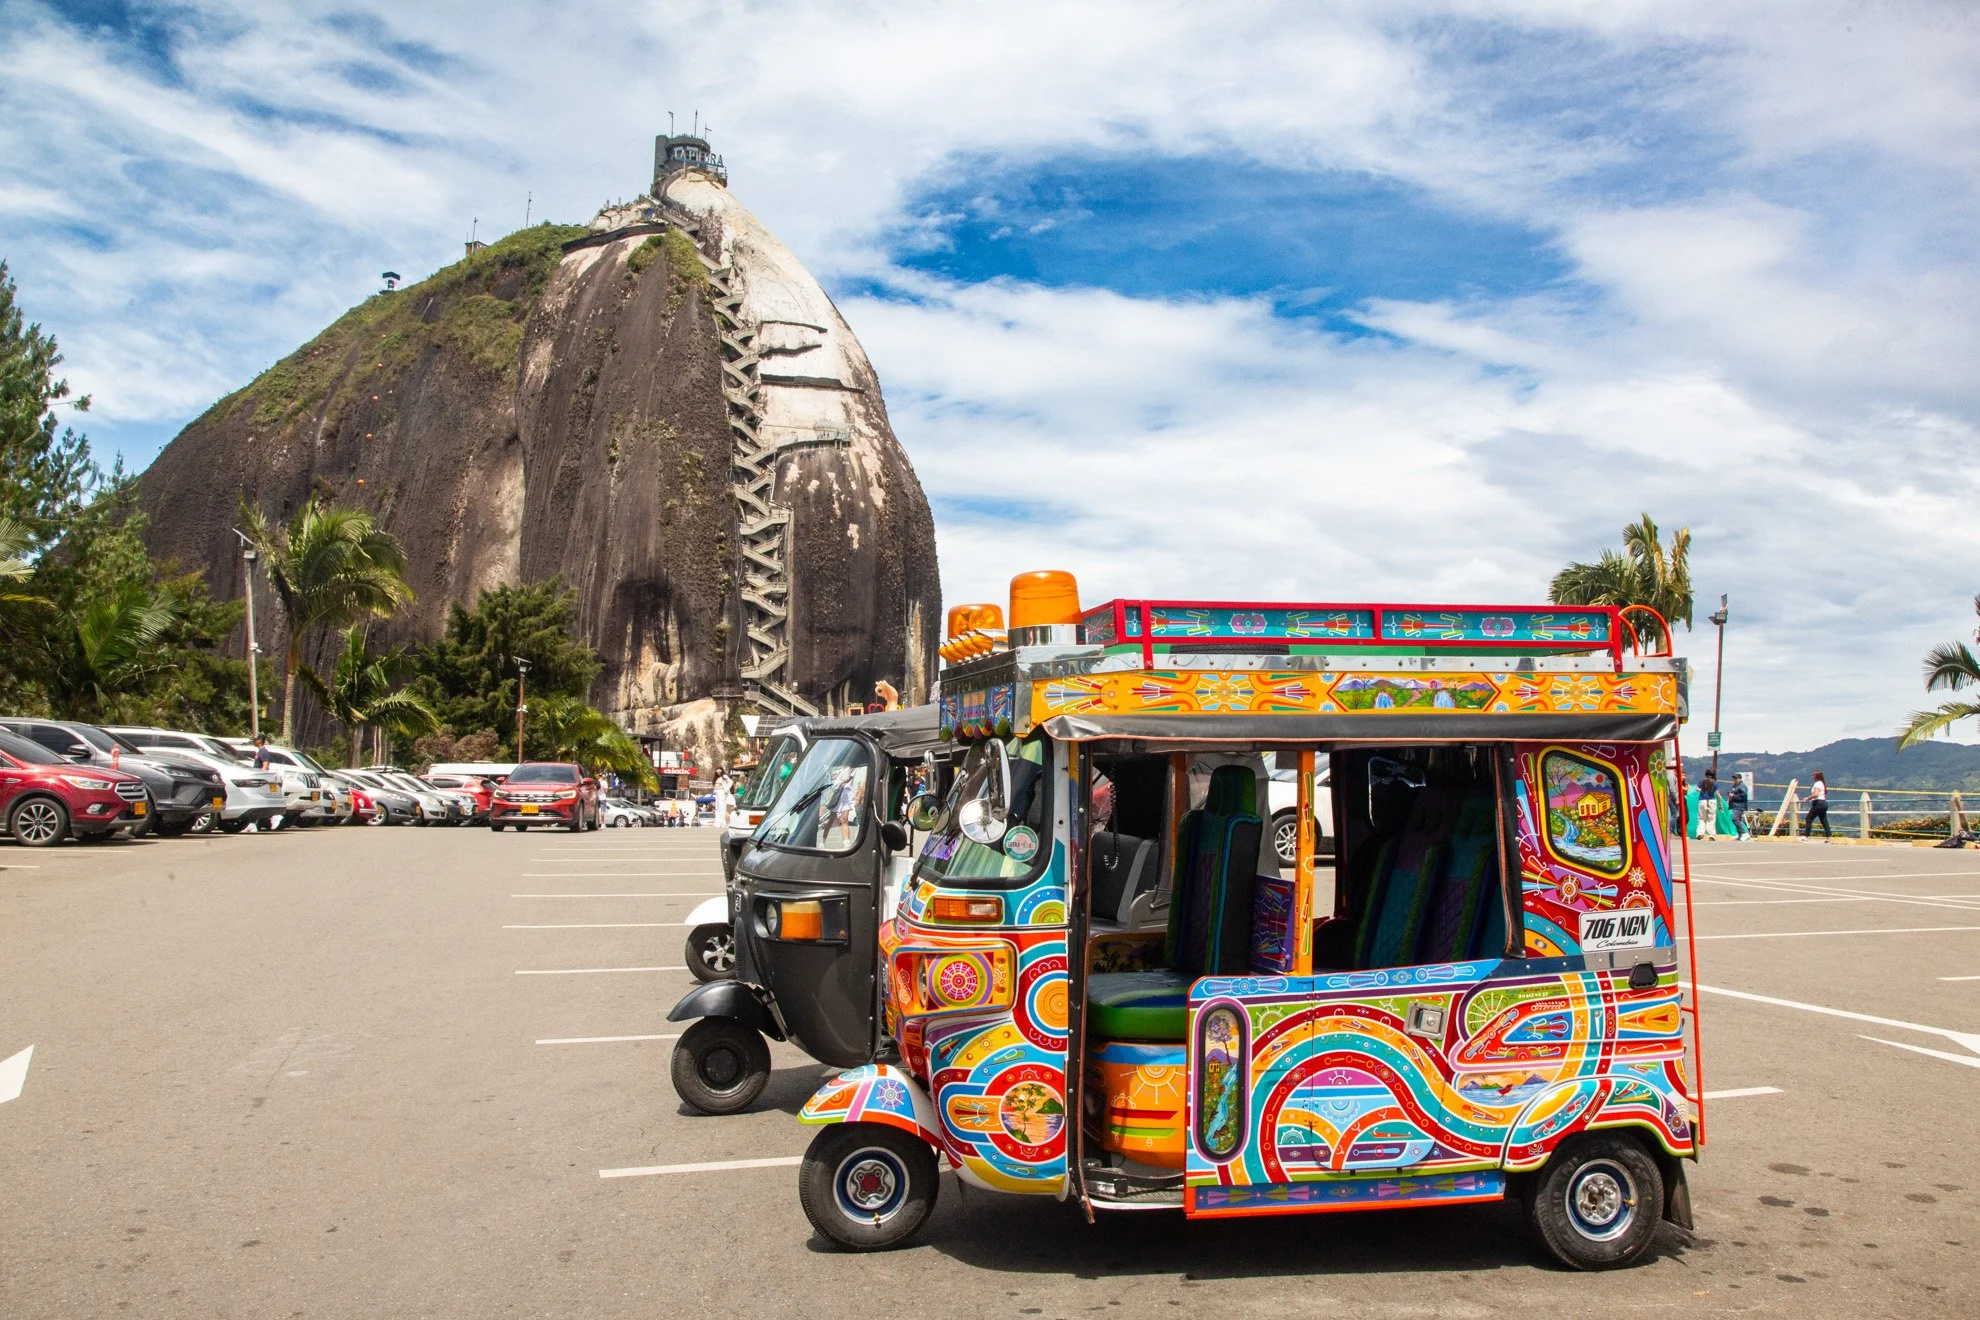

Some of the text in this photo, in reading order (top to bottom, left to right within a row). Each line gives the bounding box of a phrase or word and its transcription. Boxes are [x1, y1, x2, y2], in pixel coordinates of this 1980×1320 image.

[1583, 915, 1650, 940] 706 NCN
[1596, 939, 1639, 948] Colombia
